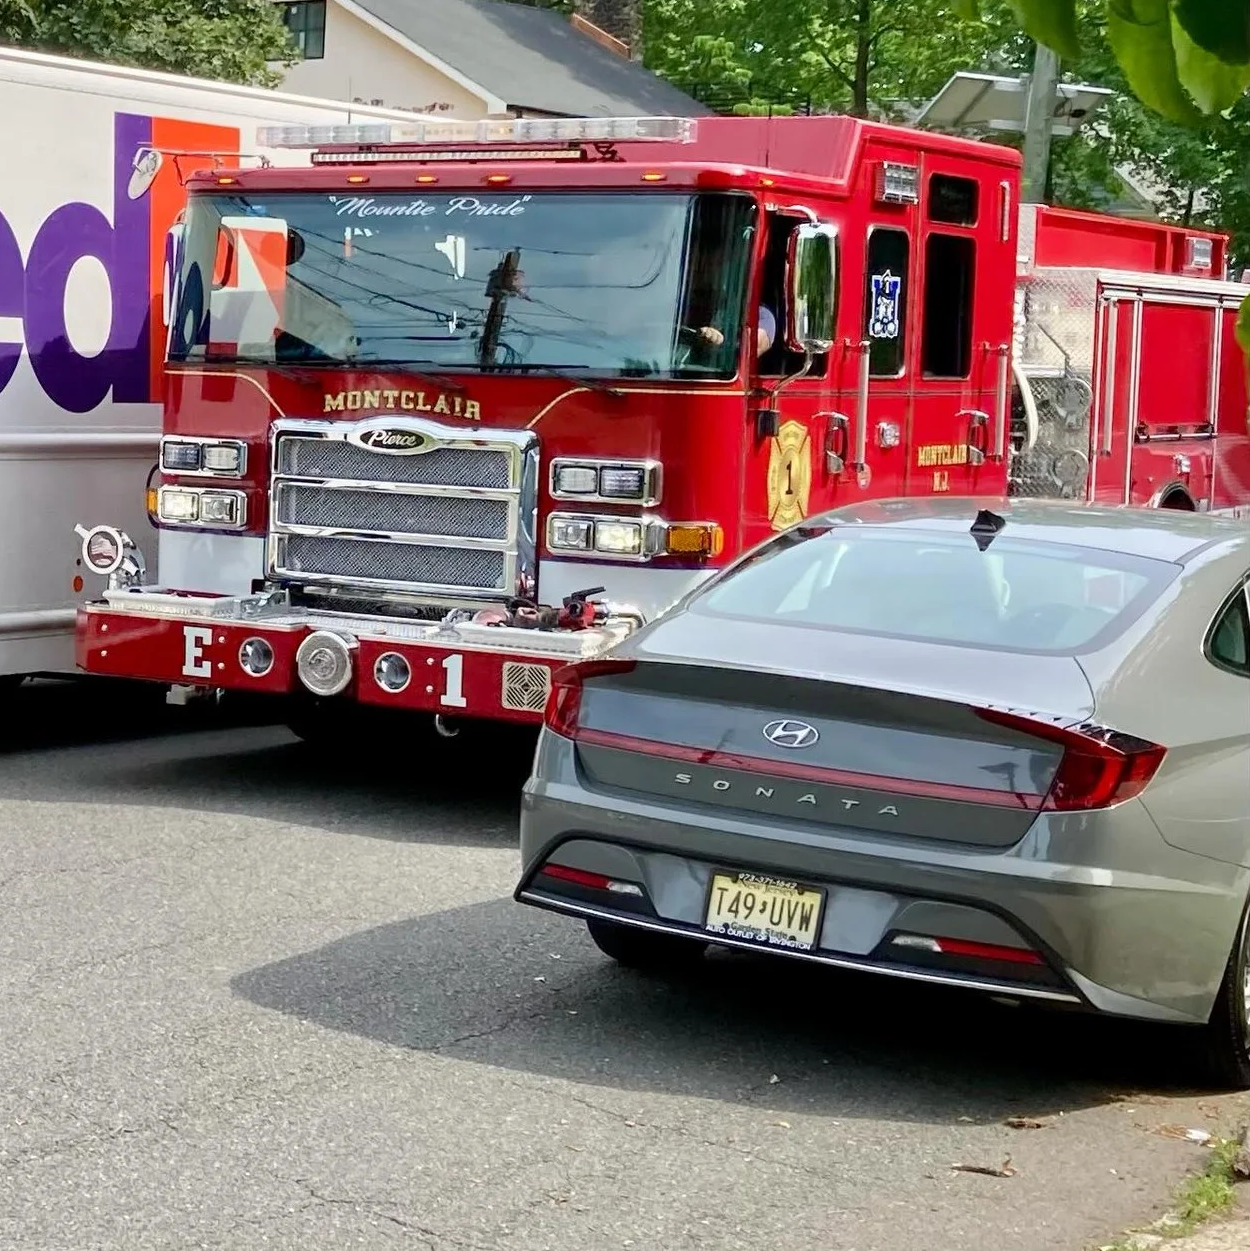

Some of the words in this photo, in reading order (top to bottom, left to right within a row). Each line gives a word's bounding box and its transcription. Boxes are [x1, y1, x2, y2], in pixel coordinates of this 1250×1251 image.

[323, 390, 481, 420] MONTCLAIR
[367, 429, 417, 447] Pierce
[918, 444, 967, 467] MONTCLAIR
[785, 460, 794, 495] 1
[182, 626, 212, 678] E
[440, 653, 467, 708] 1
[675, 773, 899, 817] SONATA
[705, 925, 726, 934] AUTO
